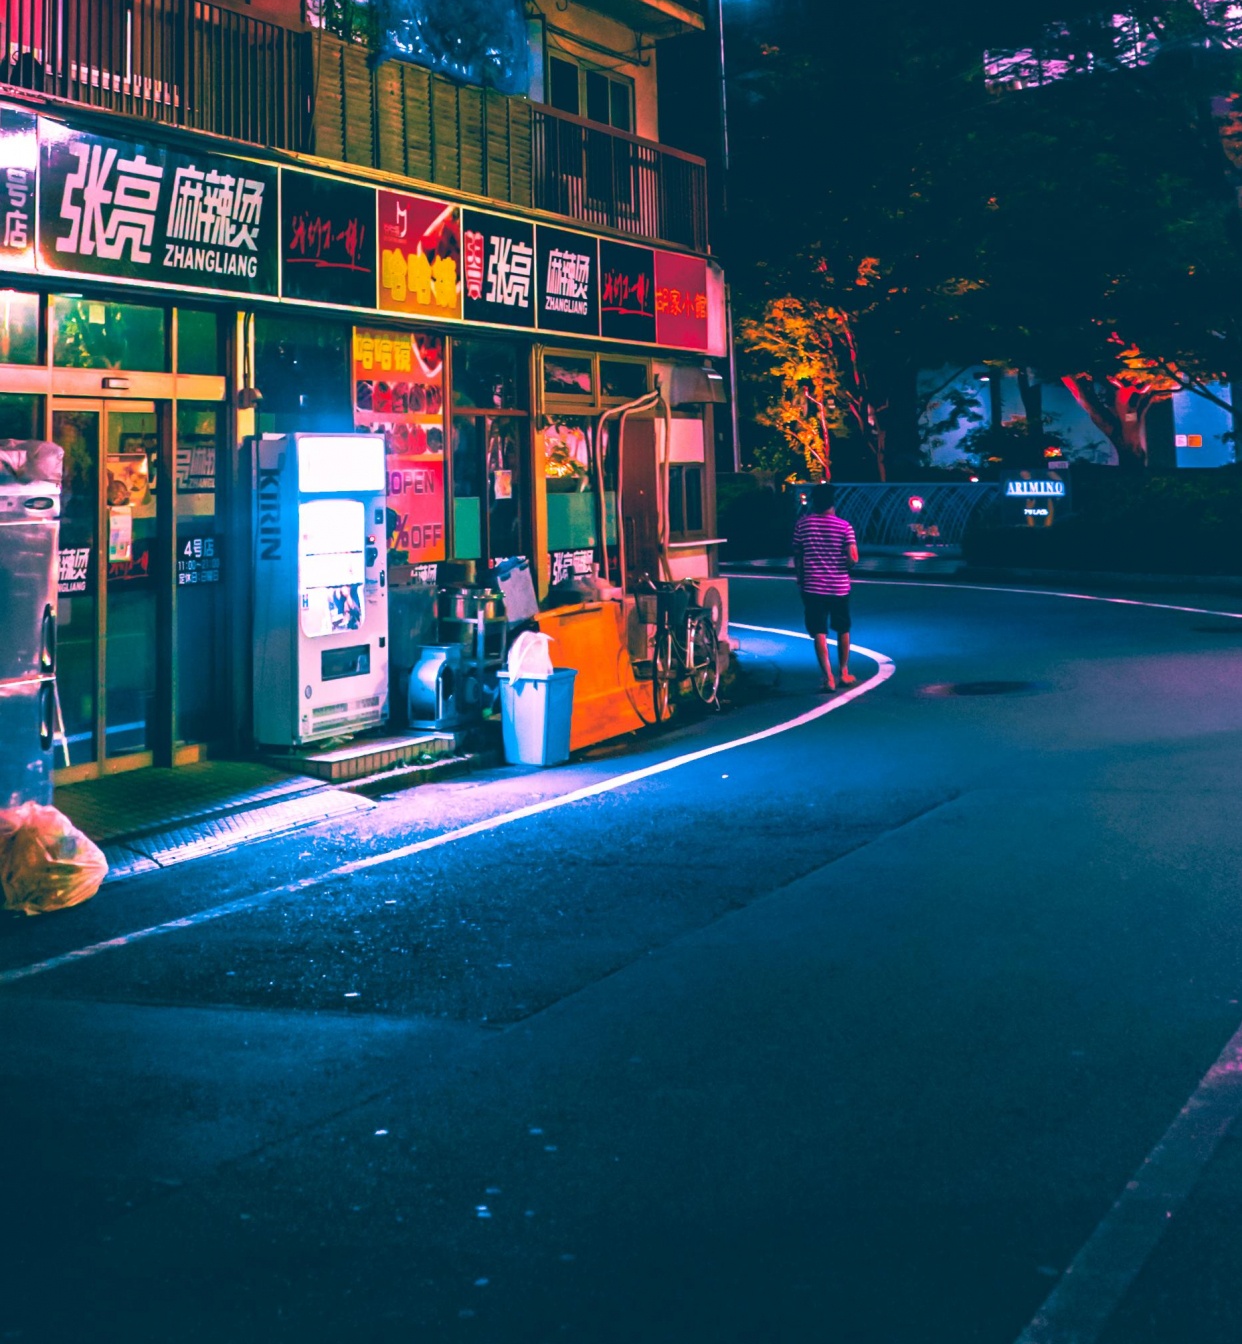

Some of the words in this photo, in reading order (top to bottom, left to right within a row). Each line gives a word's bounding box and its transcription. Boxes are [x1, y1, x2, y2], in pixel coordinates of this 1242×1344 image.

[56, 142, 164, 264] 张亮
[163, 243, 258, 279] ZHANGLIANG
[486, 236, 532, 308] 张亮
[545, 296, 588, 316] ZHANGLIANG
[386, 470, 435, 496] OPEN
[1007, 481, 1064, 495] ARIMINO
[260, 468, 281, 561] KIRIN
[184, 538, 215, 558] 4号店
